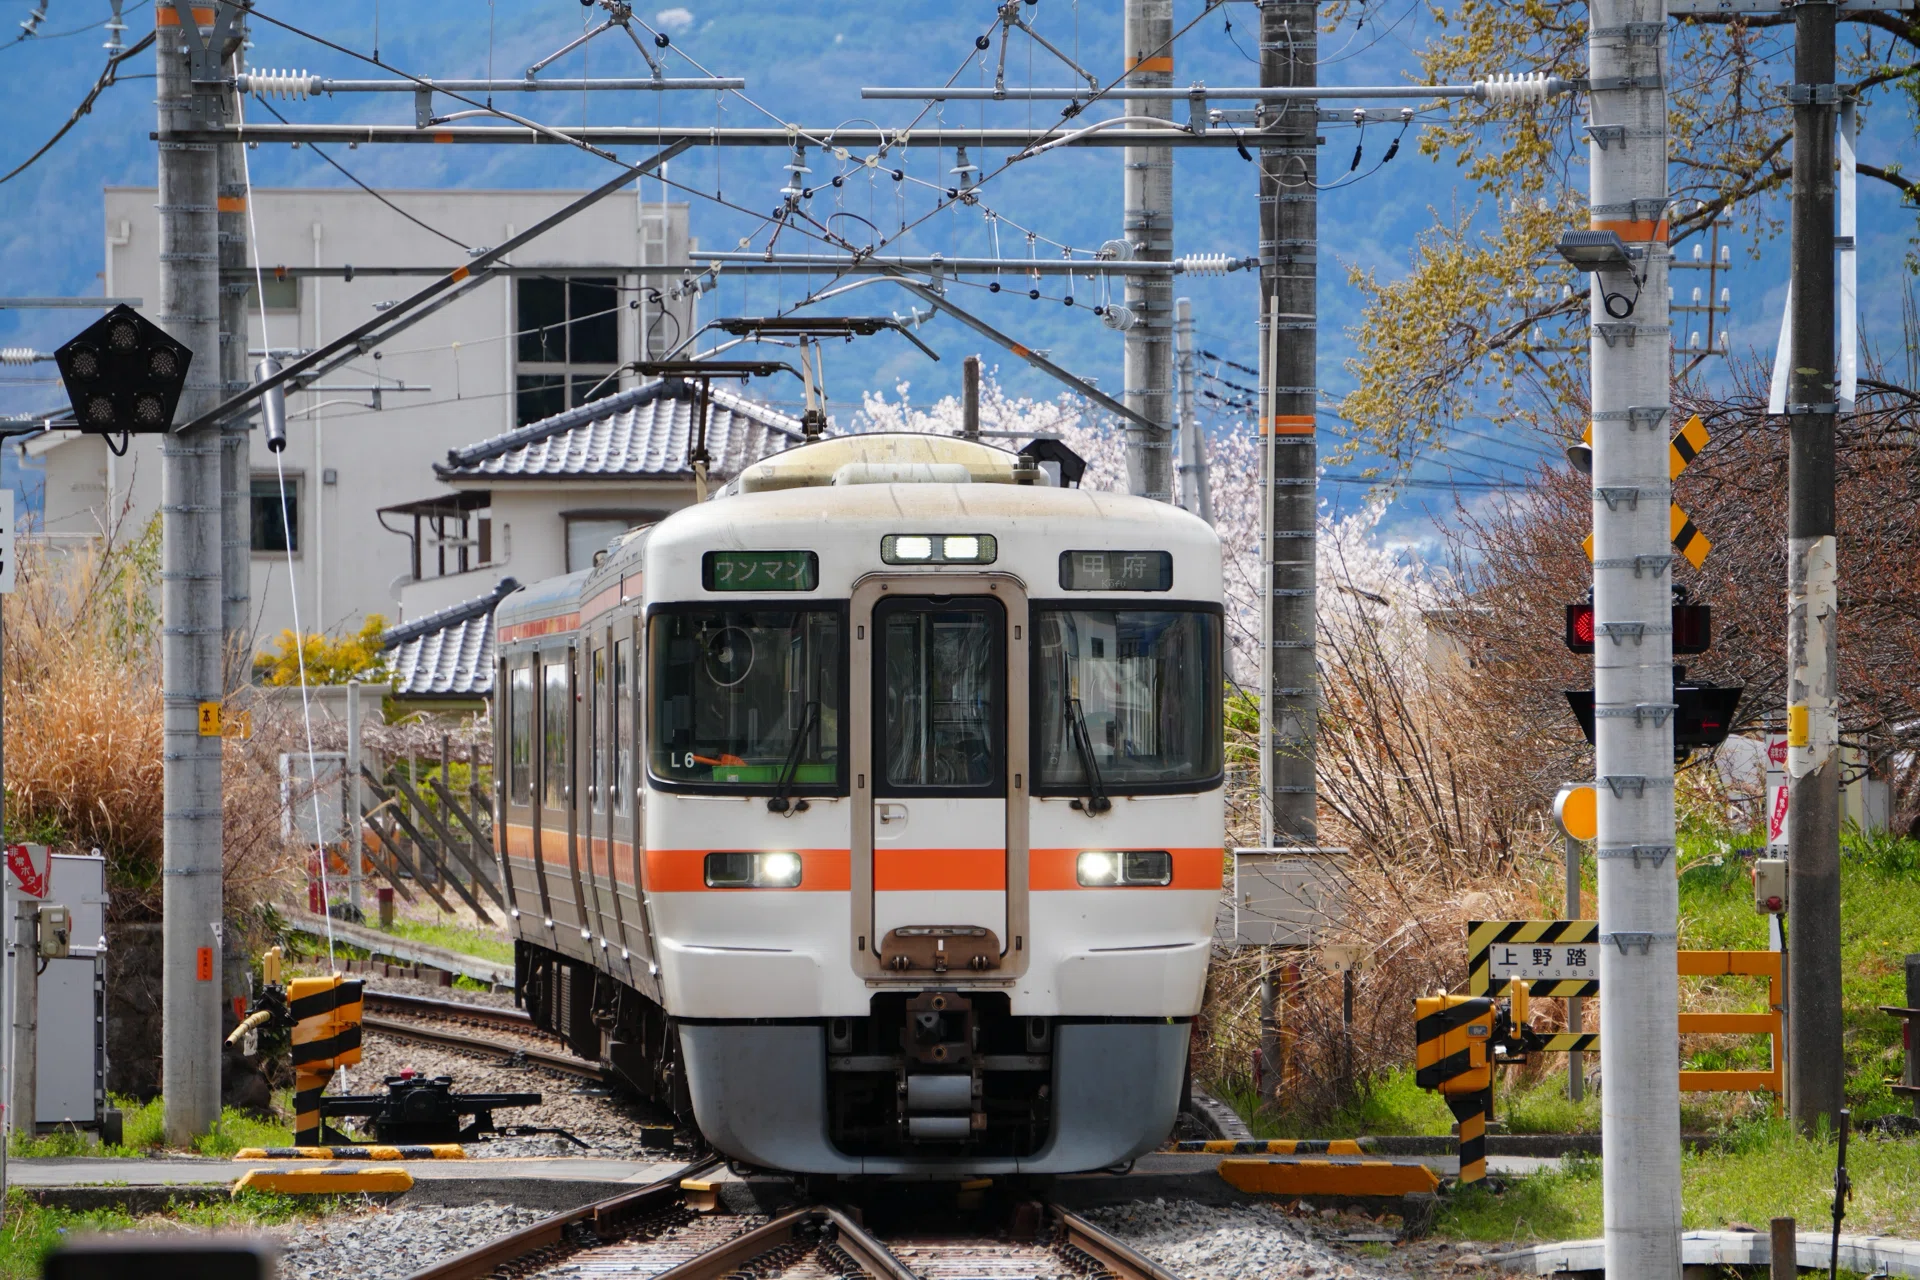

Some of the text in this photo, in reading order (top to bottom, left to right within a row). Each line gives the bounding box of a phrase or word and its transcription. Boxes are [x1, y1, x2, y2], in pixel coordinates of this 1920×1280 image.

[716, 561, 806, 581] ワンマン
[1082, 554, 1147, 579] 甲府
[9, 847, 42, 895] 非常ボタン
[1498, 948, 1587, 967] 上野踏
